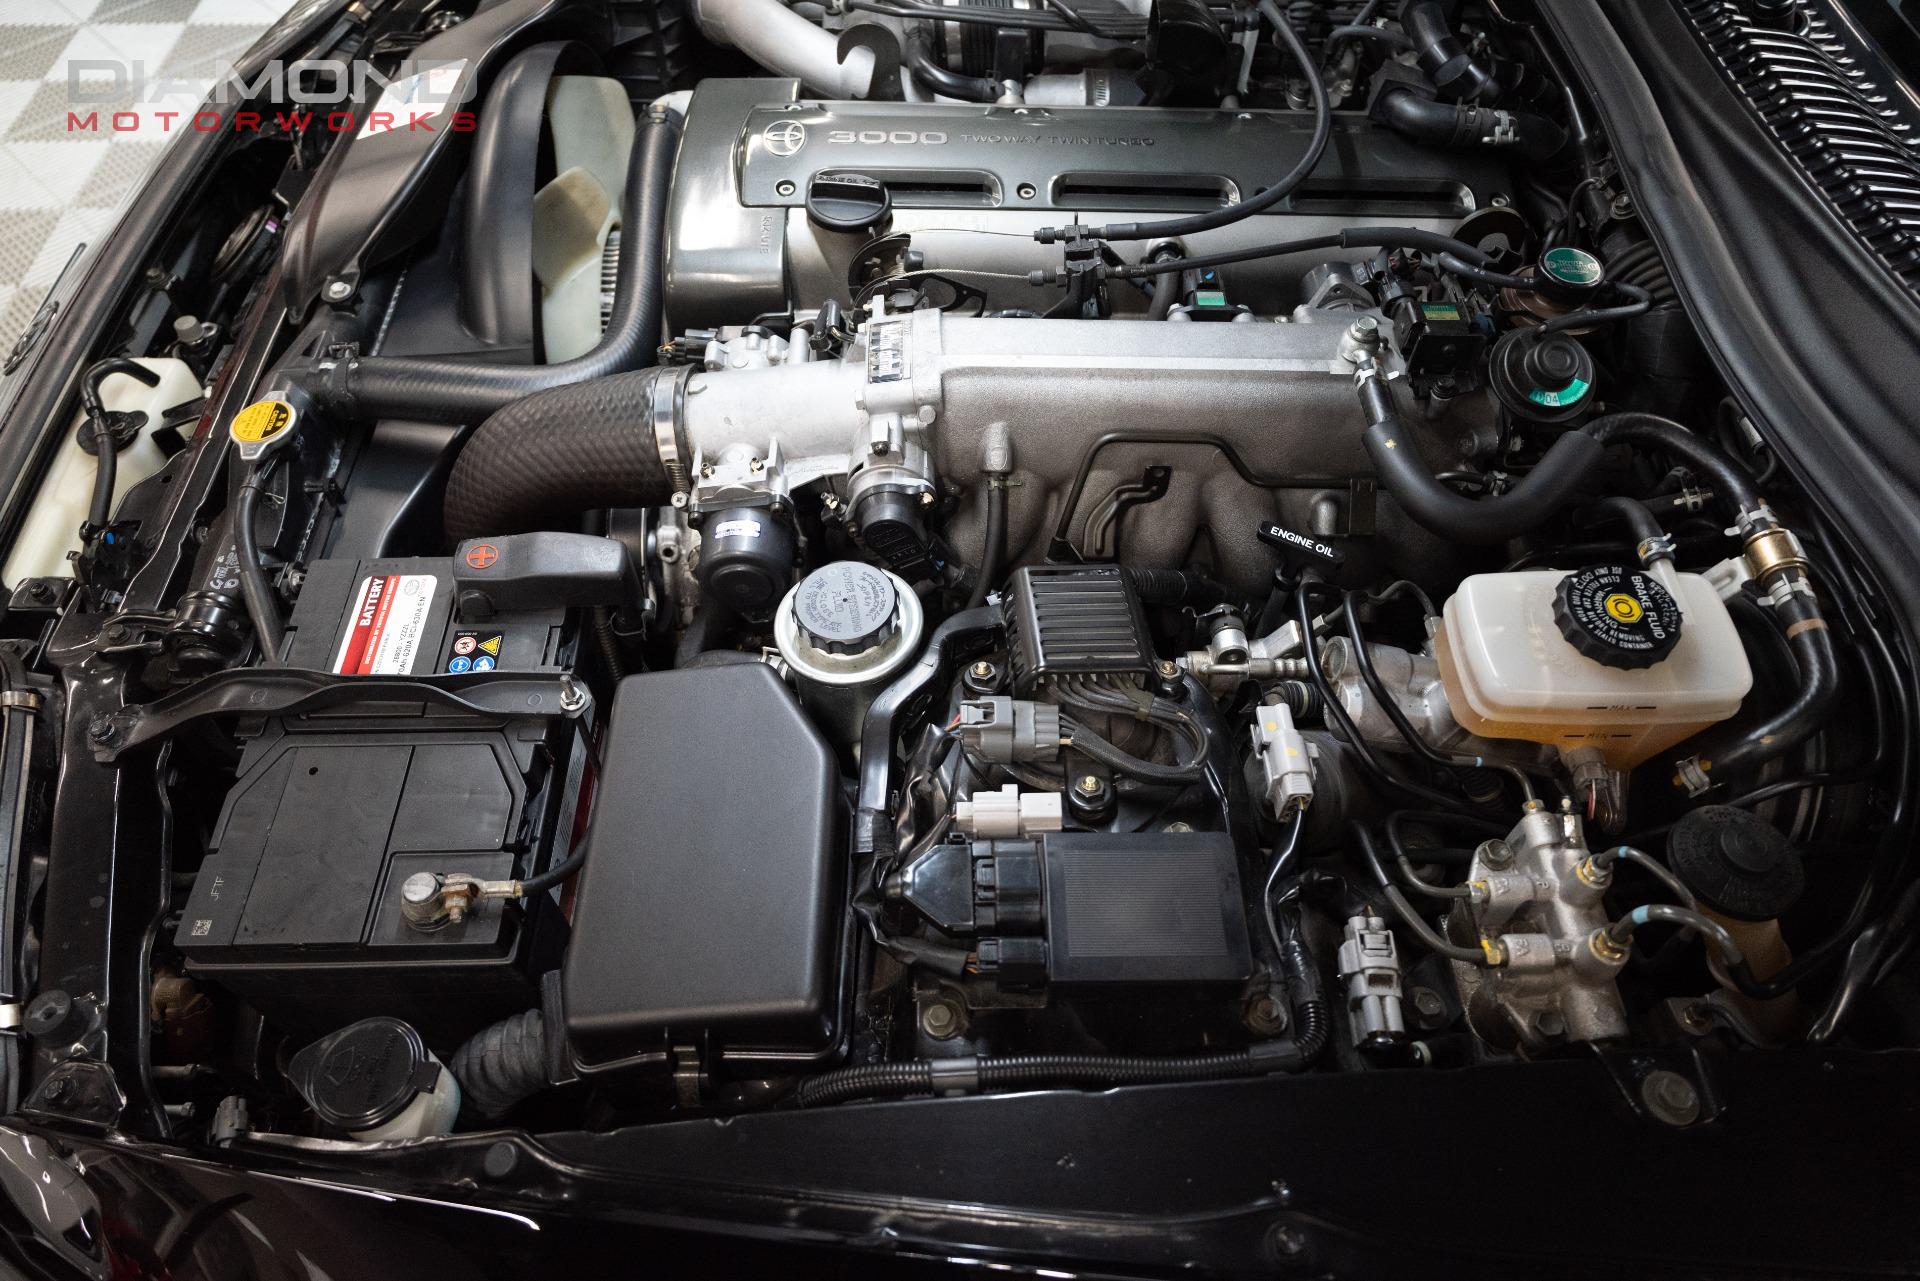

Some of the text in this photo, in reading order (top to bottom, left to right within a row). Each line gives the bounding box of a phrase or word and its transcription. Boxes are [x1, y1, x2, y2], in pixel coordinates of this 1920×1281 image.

[828, 130, 1155, 146] 3000 TWO WAY TWIN TURBO
[1270, 526, 1334, 558] ENGINE OIL
[1575, 572, 1594, 589] DOT3
[1583, 580, 1600, 596] FILLER
[1598, 576, 1620, 584] CLEAN
[359, 578, 385, 626] BATTERY
[832, 590, 844, 612] FLUID
[842, 566, 862, 632] POWER STEERING
[1572, 590, 1581, 605] FLUID
[1582, 597, 1592, 609] CAP
[1576, 607, 1589, 622] FROM
[1593, 590, 1618, 628] WARNING
[1631, 575, 1666, 640] BRAKE FLUID
[1586, 611, 1608, 631] BEFORE
